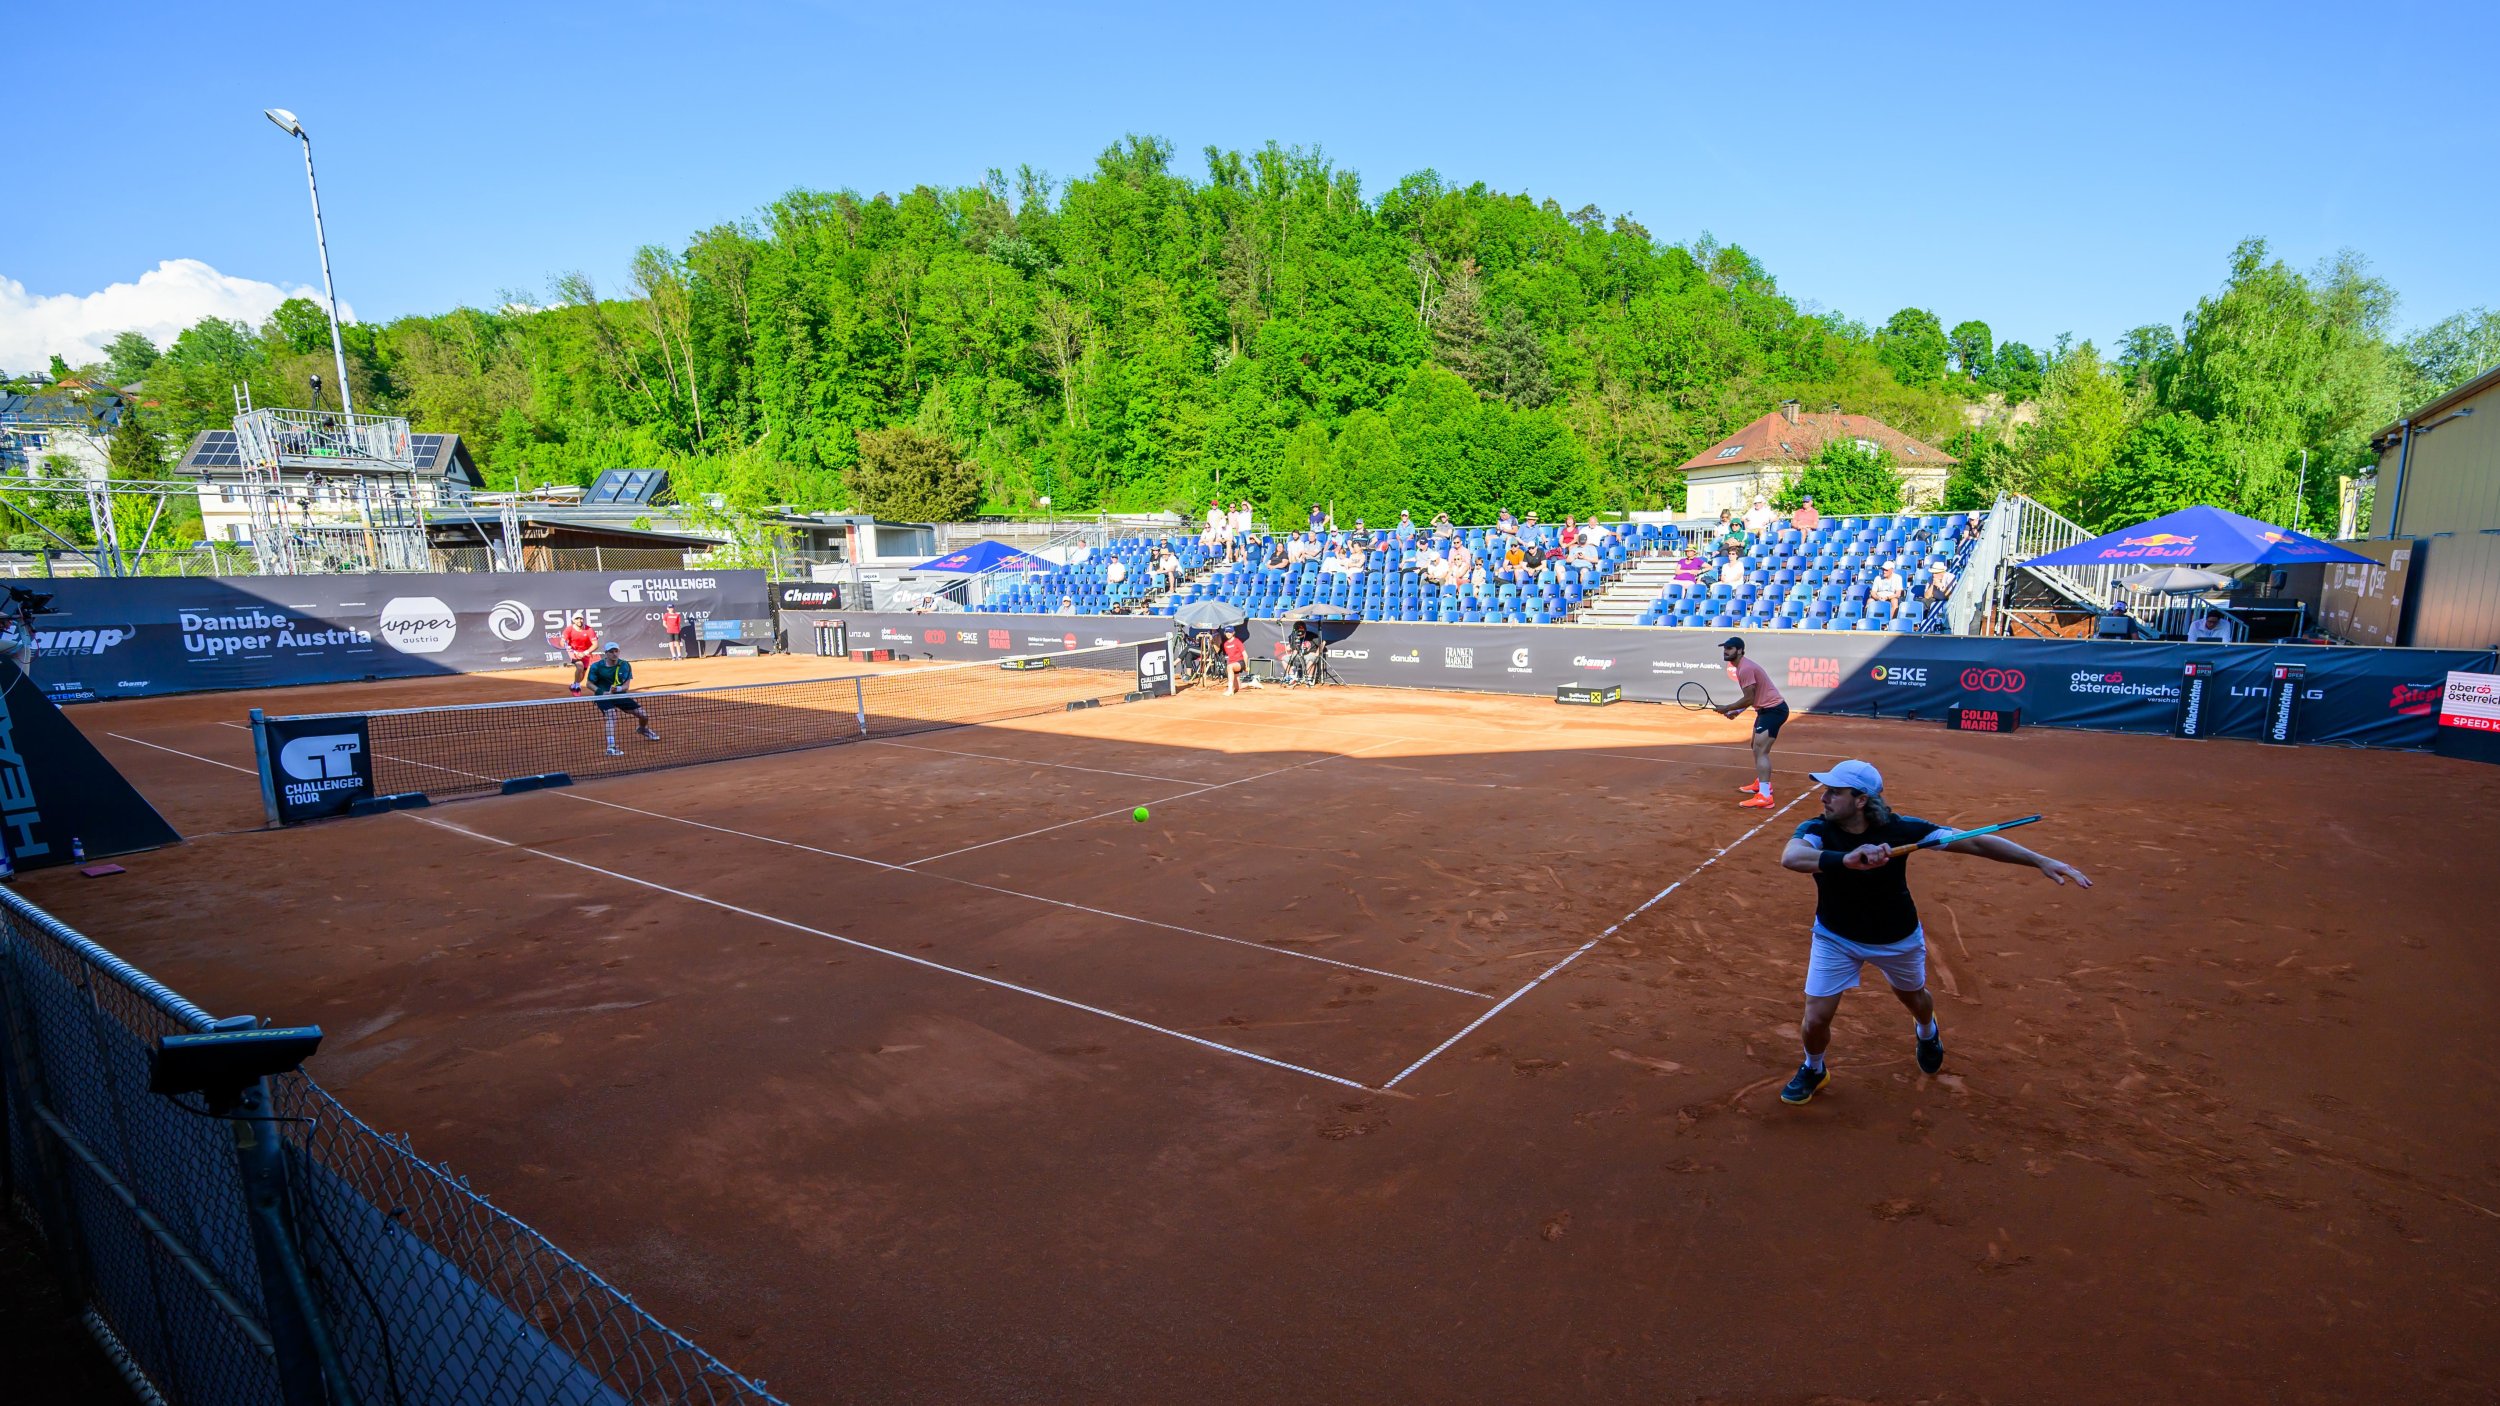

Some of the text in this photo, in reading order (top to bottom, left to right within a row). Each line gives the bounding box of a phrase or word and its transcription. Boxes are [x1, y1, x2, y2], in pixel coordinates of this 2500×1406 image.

[2098, 546, 2197, 559] Red Bull
[645, 578, 717, 590] CHALLENGER
[646, 590, 679, 602] TOUR
[784, 588, 833, 605] Champ
[179, 610, 295, 632] Danube,
[380, 618, 456, 635] upper
[183, 626, 372, 656] Upper Austria
[402, 635, 439, 644] austria
[962, 632, 978, 640] SKE
[30, 647, 92, 657] EVENTS
[1324, 650, 1368, 659] HEAD
[1445, 647, 1474, 657] FRANKEN
[1573, 655, 1612, 670] Champ
[1788, 656, 1840, 673] COLDA
[1140, 674, 1168, 684] CHALLENGER
[1788, 672, 1840, 688] MARIS
[1888, 667, 1928, 682] SKE
[1966, 668, 2019, 689] ÖTV
[1140, 682, 1153, 691] TOUR
[2069, 681, 2181, 697] österreichische
[2230, 686, 2268, 697] LIN
[2389, 684, 2443, 708] Stiegl
[2183, 679, 2203, 735] OÖNachrichten
[2272, 683, 2294, 740] OÖNachrichten
[1960, 709, 1999, 721] COLDA
[1960, 720, 1999, 732] MARIS
[2452, 717, 2490, 729] SPEED
[332, 743, 357, 752] ATP
[0, 684, 50, 859] HEA
[285, 777, 364, 796] CHALLENGER
[286, 792, 320, 806] TOUR
[184, 1030, 296, 1042] FOXTENN
